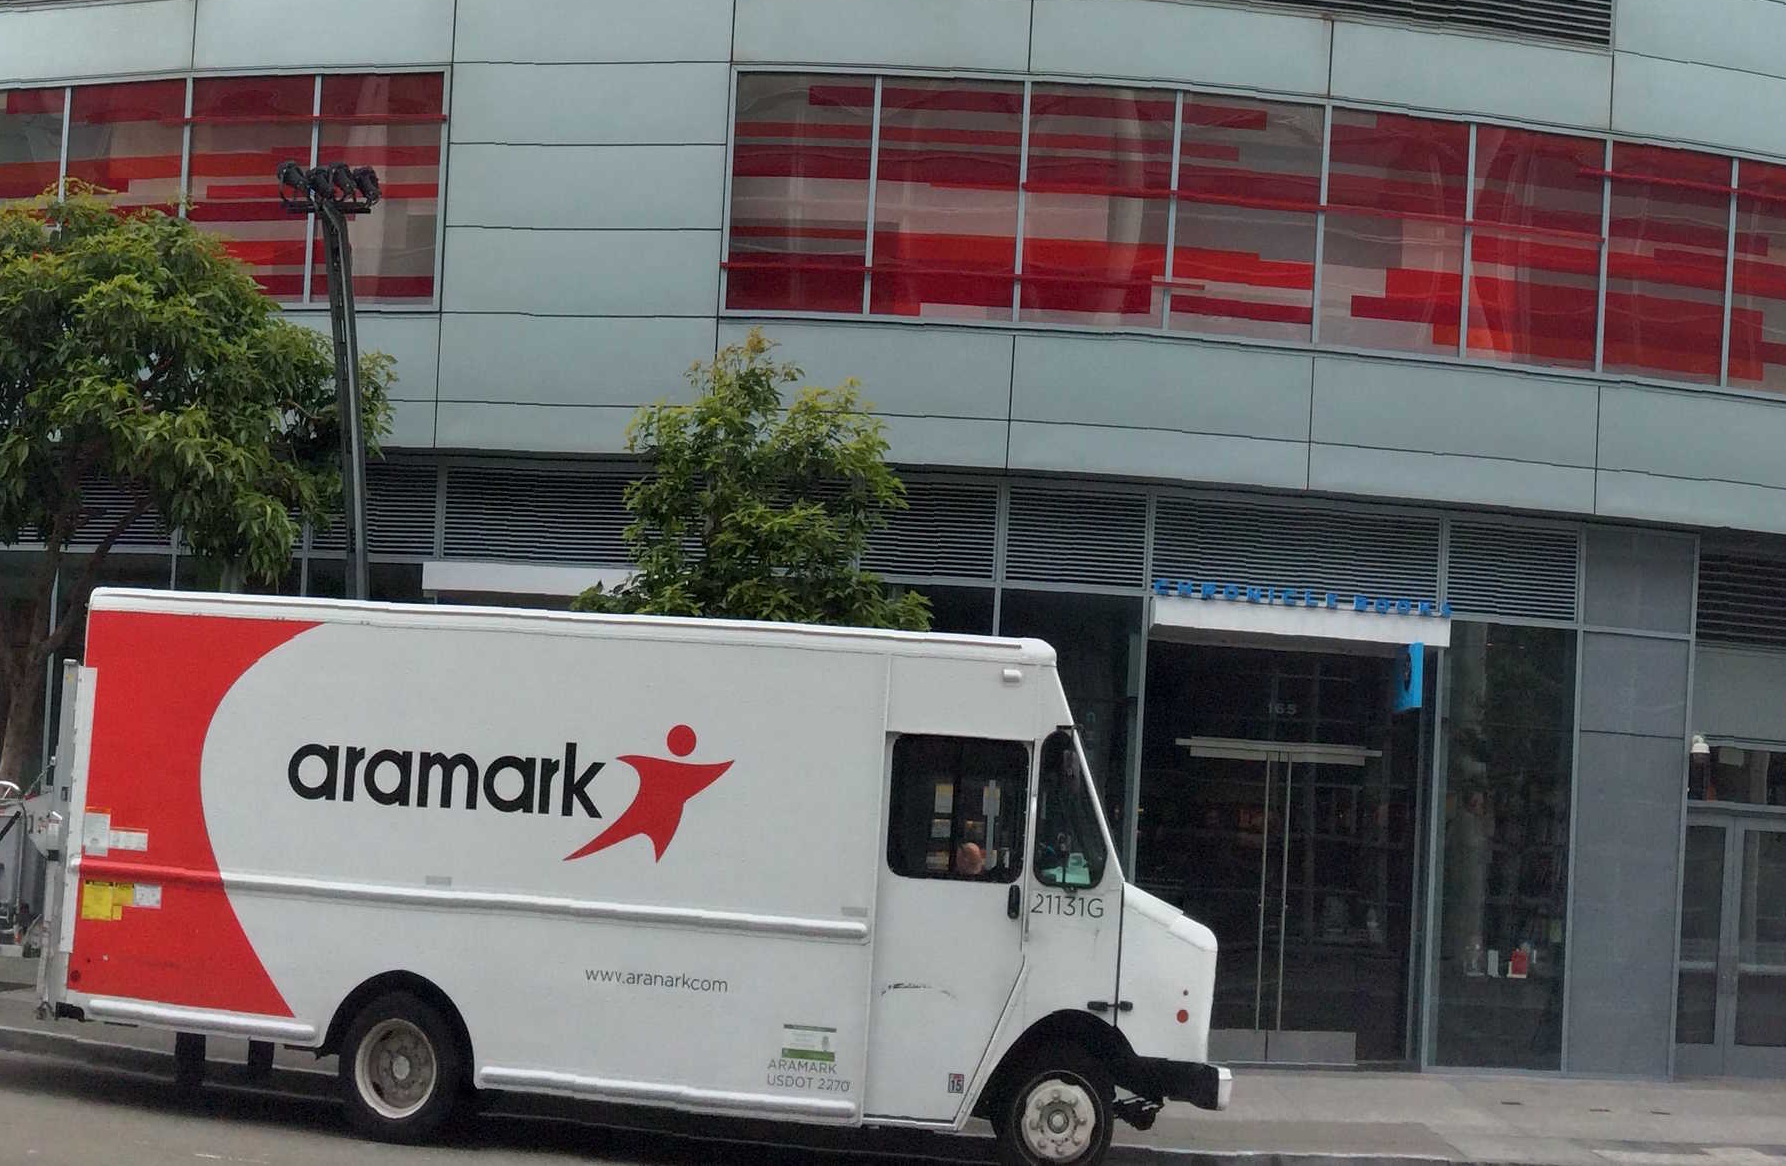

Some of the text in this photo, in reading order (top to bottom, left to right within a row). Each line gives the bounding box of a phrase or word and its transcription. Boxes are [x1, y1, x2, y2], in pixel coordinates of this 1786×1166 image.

[1152, 578, 1453, 618] CHRONICLE BOOKS
[1267, 702, 1297, 716] 165
[287, 741, 608, 819] aramark
[1030, 893, 1105, 918] 21131G
[766, 1059, 838, 1075] ARAMARK
[766, 1074, 814, 1090] USDOT
